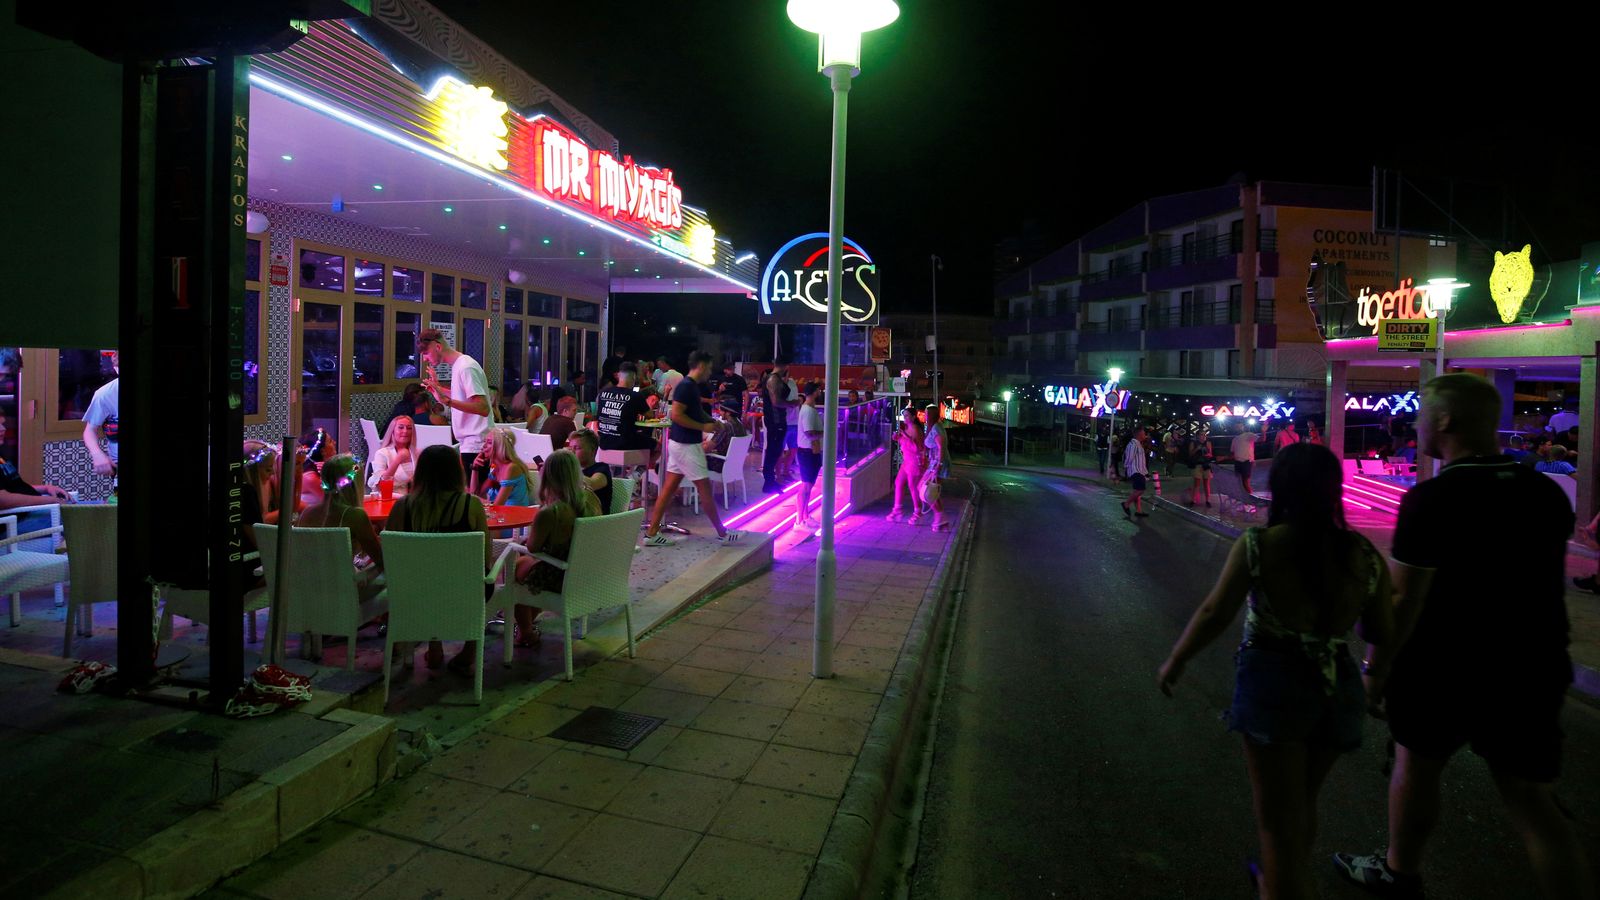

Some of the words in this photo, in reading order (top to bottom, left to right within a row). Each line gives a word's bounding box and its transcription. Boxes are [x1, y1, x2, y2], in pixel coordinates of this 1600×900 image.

[233, 115, 247, 227] KRATOS
[543, 128, 591, 200] MR
[1388, 324, 1426, 332] DIRTY
[601, 392, 630, 401] MILANO
[1044, 380, 1131, 417] GALAXY
[601, 407, 622, 417] FASHION
[1201, 401, 1295, 421] GALAXY
[229, 462, 241, 562] PIERCING
